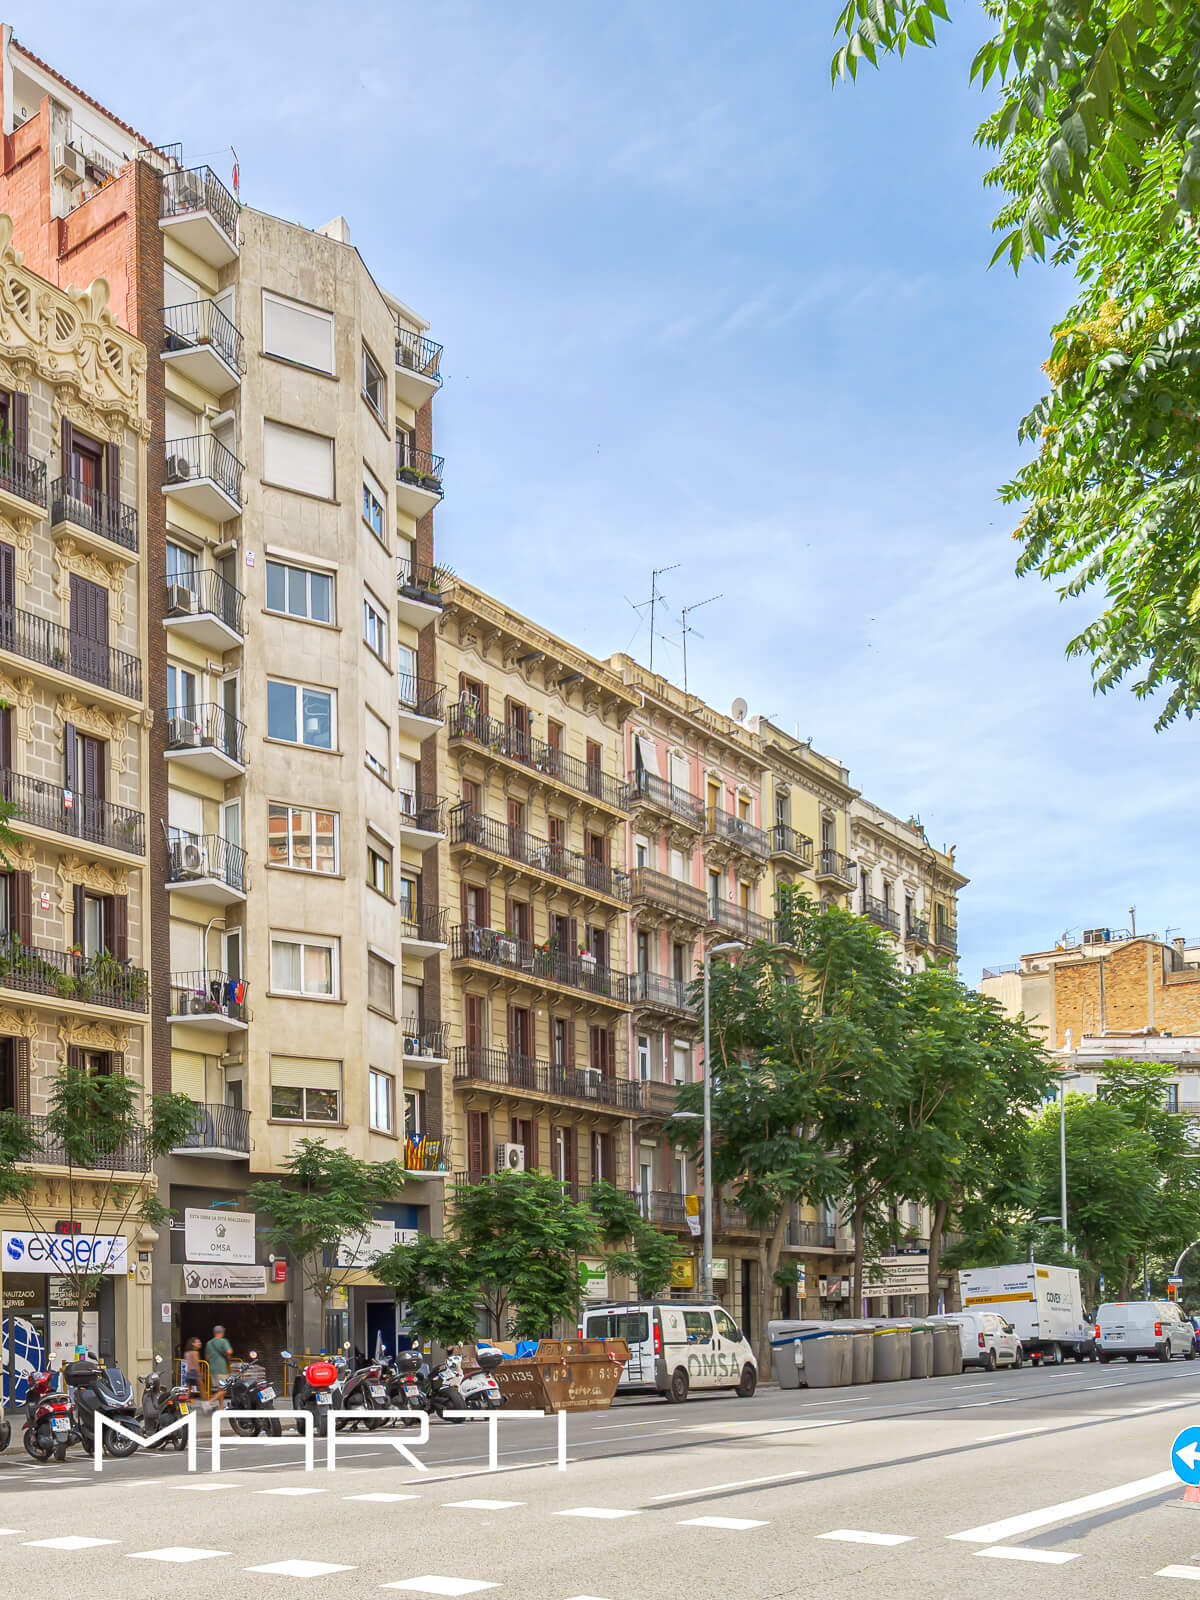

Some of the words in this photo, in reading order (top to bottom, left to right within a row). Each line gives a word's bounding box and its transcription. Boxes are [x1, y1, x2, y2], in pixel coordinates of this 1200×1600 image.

[28, 1237, 102, 1263] exser
[210, 1243, 231, 1252] OMSA
[201, 1278, 230, 1289] OMSA
[688, 1352, 741, 1376] OMSA
